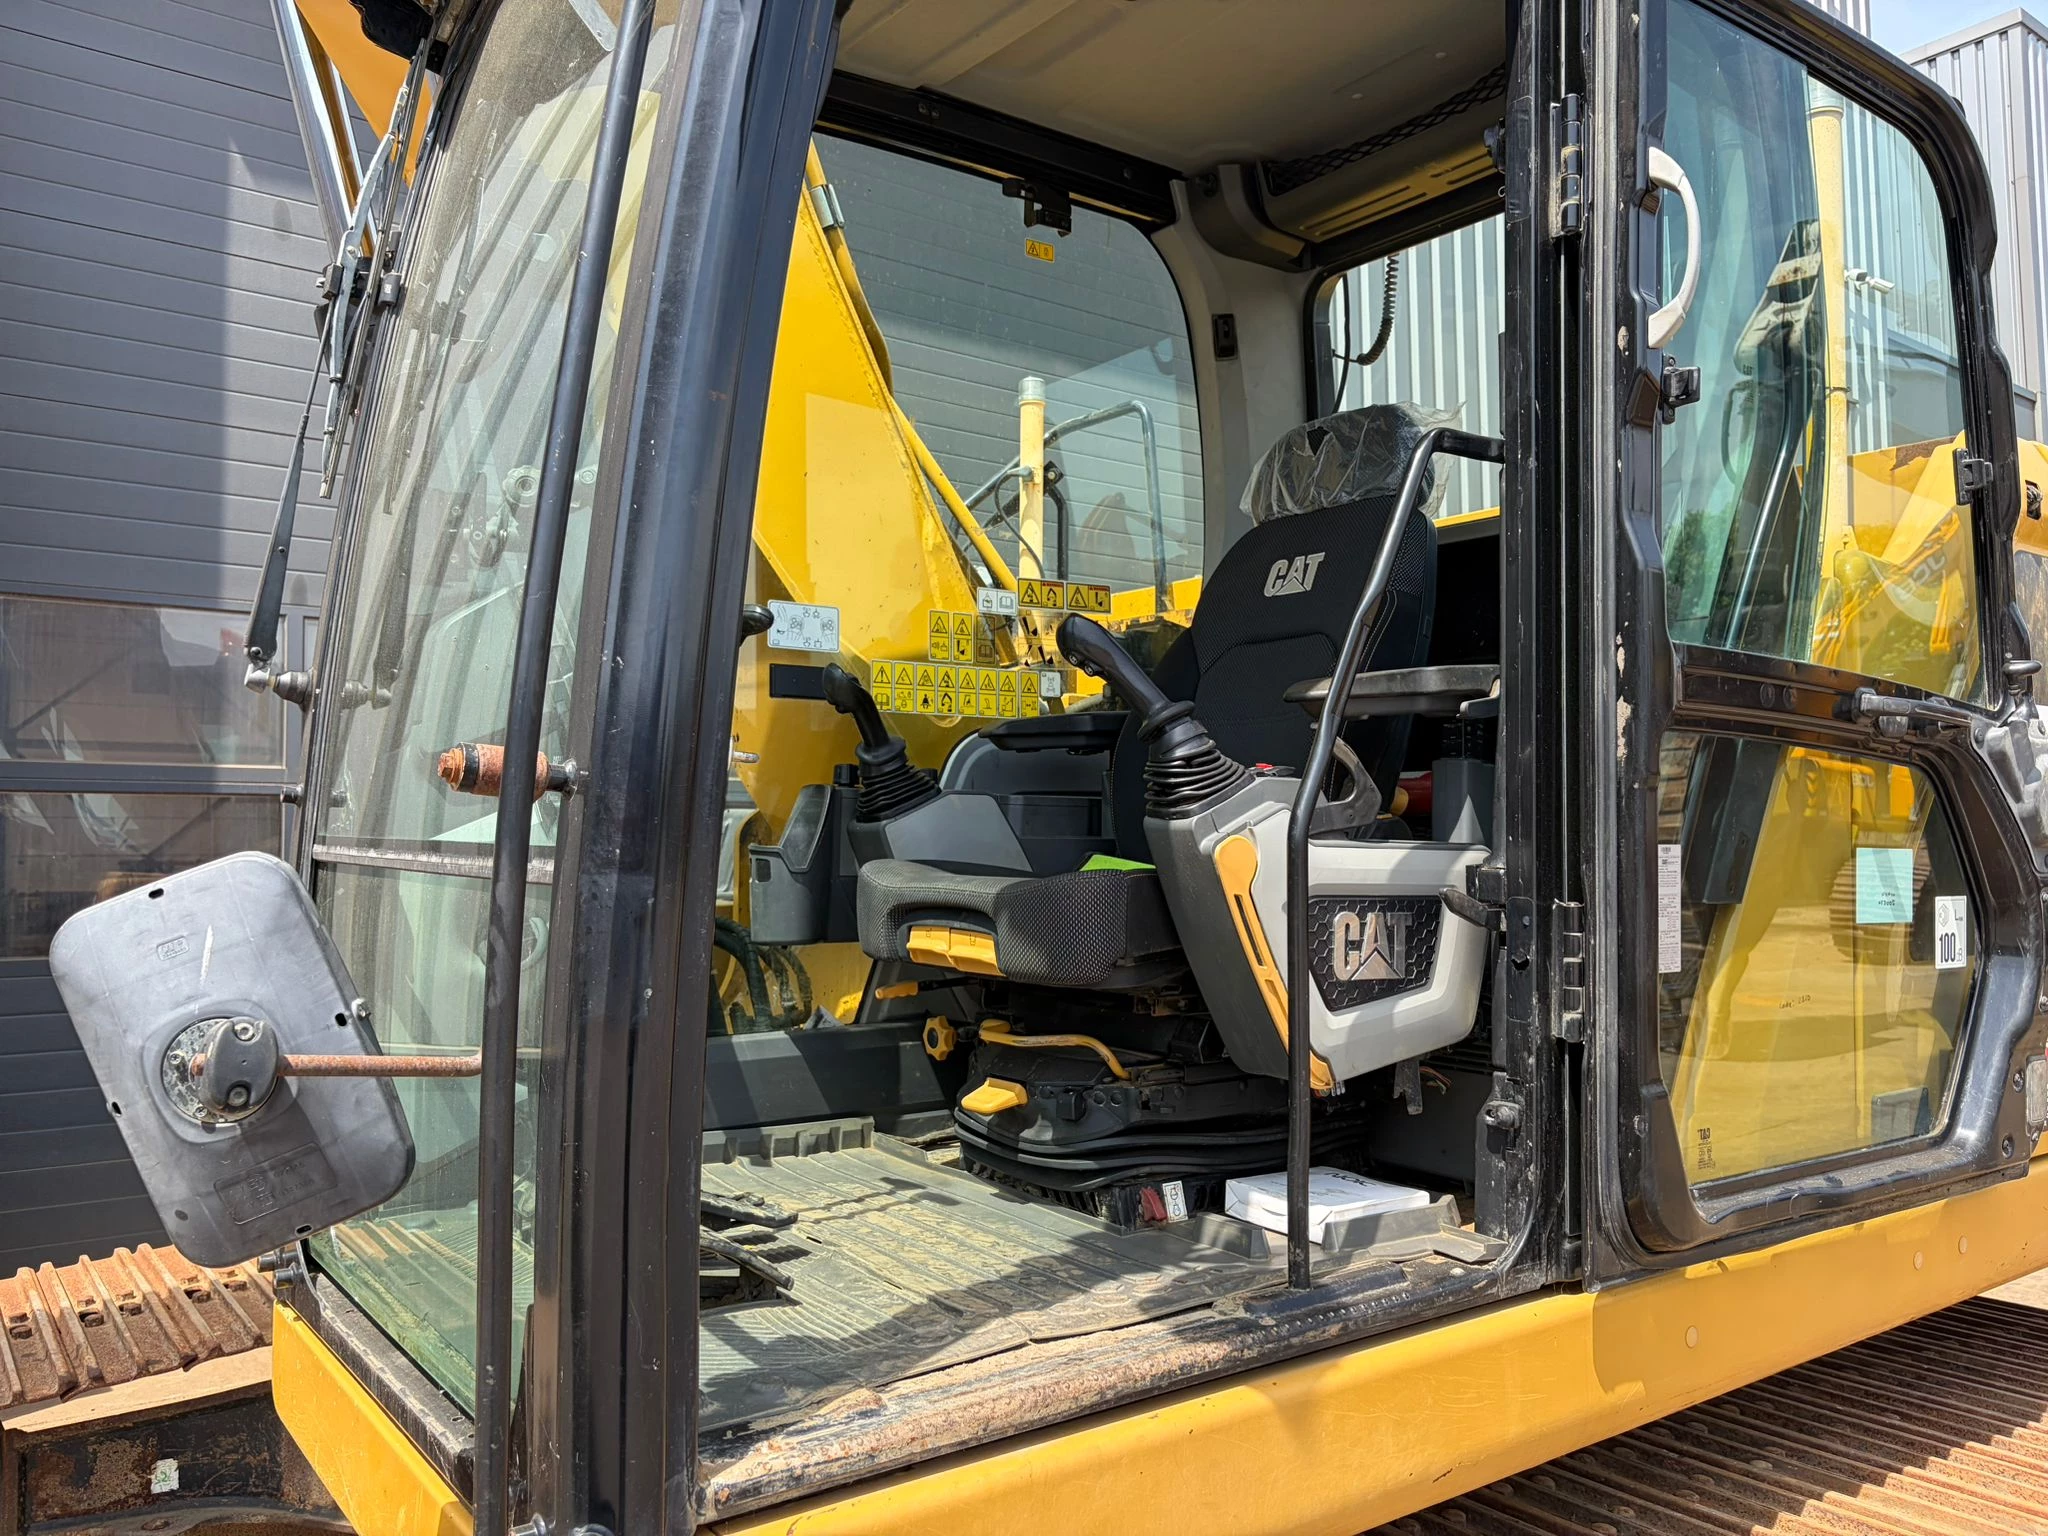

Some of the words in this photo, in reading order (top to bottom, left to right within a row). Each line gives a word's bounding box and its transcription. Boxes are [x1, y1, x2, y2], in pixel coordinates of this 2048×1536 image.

[1264, 552, 1325, 598] CAT
[1333, 912, 1413, 981] CAT
[1939, 932, 1956, 963] 100
